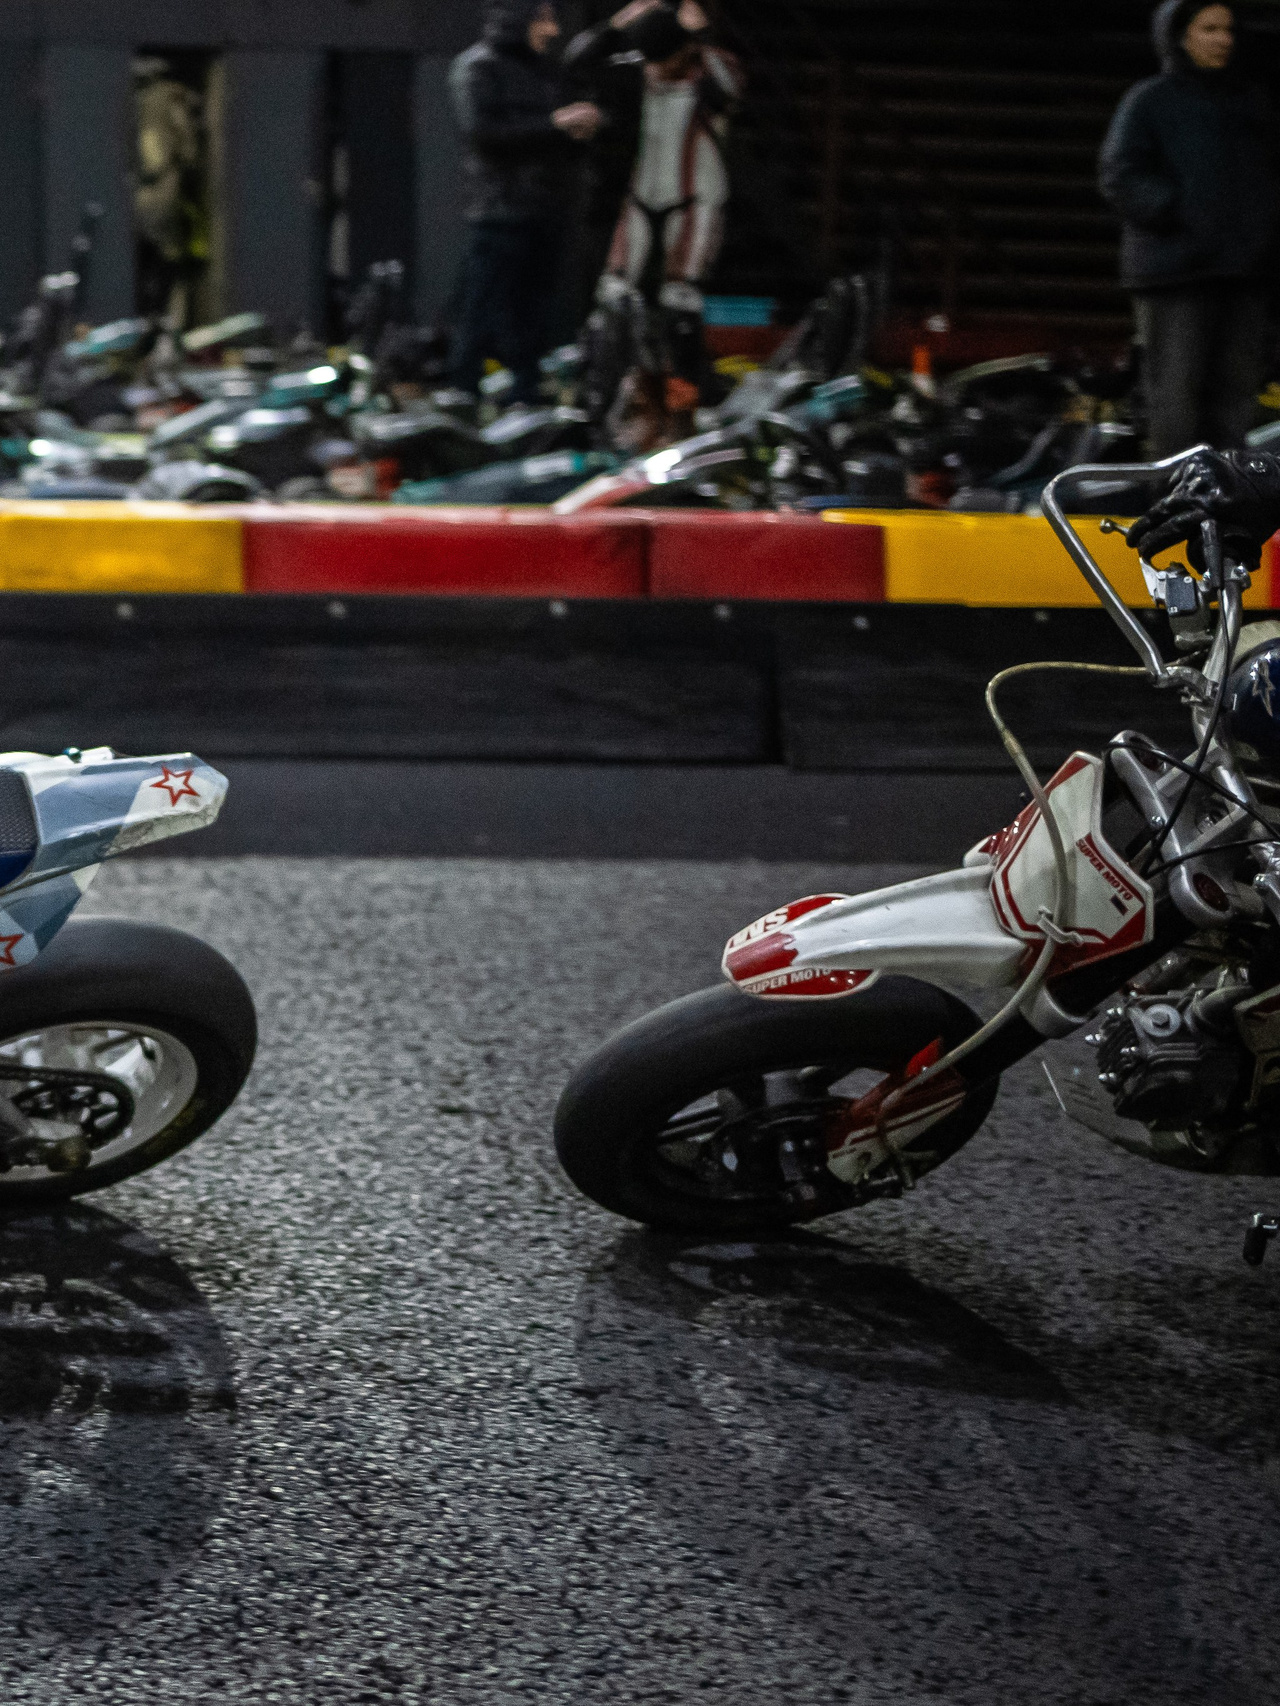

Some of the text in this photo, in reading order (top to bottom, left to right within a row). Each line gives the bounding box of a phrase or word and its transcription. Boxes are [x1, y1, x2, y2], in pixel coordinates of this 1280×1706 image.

[1075, 838, 1134, 901] SUPER MOTO
[743, 968, 831, 994] SUPER MOTO
